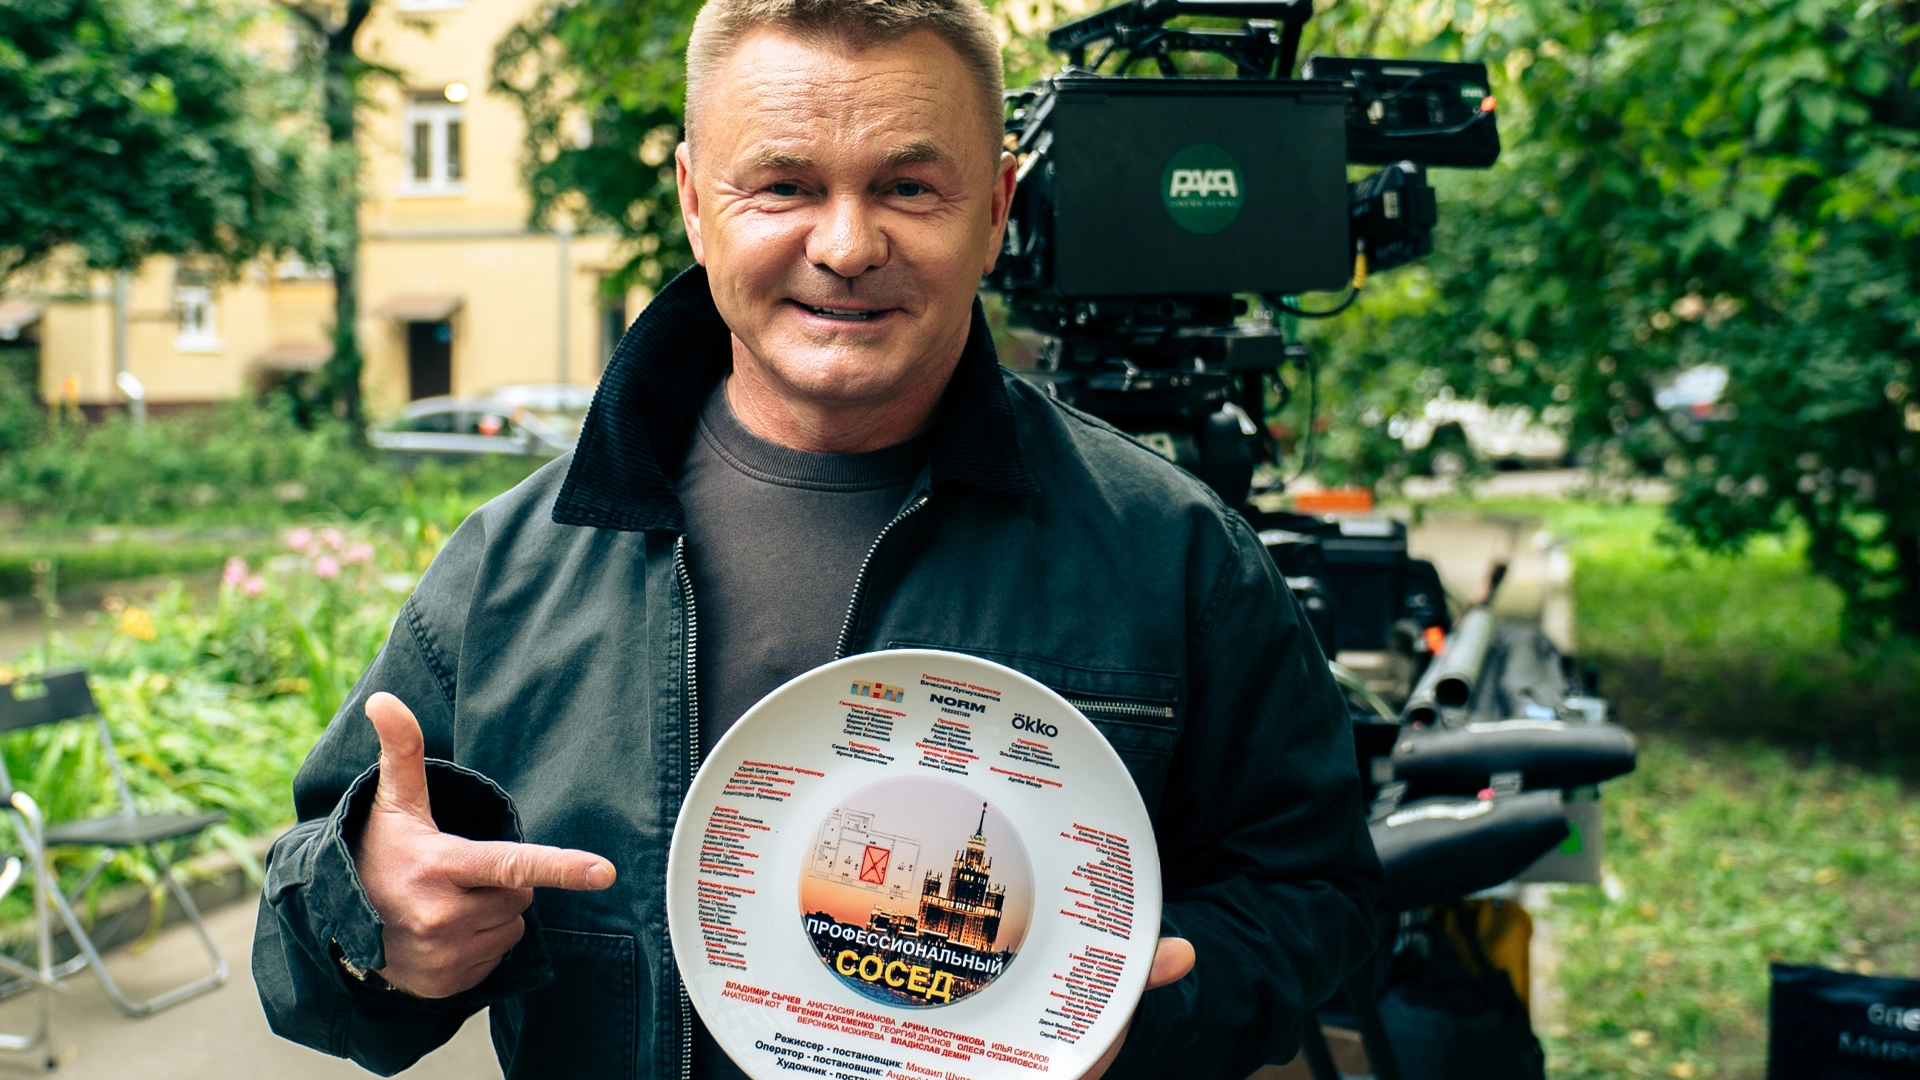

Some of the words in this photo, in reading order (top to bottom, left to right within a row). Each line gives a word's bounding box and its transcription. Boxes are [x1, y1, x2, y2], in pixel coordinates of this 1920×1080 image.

[920, 679, 952, 690] Вячеслав
[952, 686, 1000, 702] Дусмухаметов
[922, 673, 967, 688] Генеральный
[968, 684, 1001, 696] продюсер
[839, 700, 874, 711] Генеральные
[875, 708, 906, 717] продюсеры
[930, 693, 986, 713] NORM
[941, 707, 970, 717] PRODUCTION
[933, 723, 953, 731] Андрей
[937, 718, 969, 729] Продюсеры
[843, 728, 862, 736] Сергей
[848, 741, 880, 751] Продюсеры
[922, 738, 946, 746] Дмитрий
[1011, 742, 1030, 750] Сергей
[1017, 738, 1048, 749] Продюсеры
[836, 750, 853, 758] Ирина
[915, 742, 947, 753] Креативные
[948, 750, 979, 760] продюсеры
[923, 750, 943, 758] авторы
[944, 755, 969, 763] сценария
[742, 760, 794, 771] Исполнительный
[794, 768, 825, 778] продюсер
[918, 760, 940, 769] Евгений
[734, 771, 764, 779] Линейный
[765, 776, 795, 785] продюсер
[990, 766, 1036, 781] Исполнительный
[1036, 778, 1062, 788] продюсер
[722, 788, 755, 798] Александра
[725, 782, 755, 791] Ассистент
[758, 788, 791, 797] продюсера
[714, 806, 739, 814] Директор
[742, 823, 770, 831] директора
[698, 879, 722, 889] Бригадир
[806, 918, 1004, 975] ПРОФЕССИОНАЛЬНЫЙ
[836, 949, 954, 1004] СОСЕД
[725, 981, 770, 997] ВЛАДИМИР
[771, 992, 801, 1004] СЫЧЕВ
[806, 1000, 855, 1016] АНАСТАСИЯ
[856, 1011, 896, 1026] ИМАМОВА
[901, 1021, 929, 1033] АРИНА
[931, 1028, 985, 1047] ПОСТНИКОВА
[991, 1043, 1013, 1053] ИЛЬЯ
[1014, 1048, 1049, 1062] СИГАЛОВ
[721, 989, 764, 1005] АНАТОЛИЙ
[764, 999, 781, 1008] КОТ
[786, 1004, 824, 1018] ЕВГЕНИЯ
[825, 1013, 874, 1029] АХРЕМЕНКО
[880, 1022, 917, 1039] ГЕОРГИЙ
[917, 1034, 951, 1048] ДРОНОВ
[957, 1043, 985, 1056] ОЛЕСЯ
[986, 1050, 1048, 1072] СУДЗИЛОВСКАЯ
[797, 1016, 839, 1031] ВЕРОНИКА
[841, 1025, 884, 1041] МОХИРЕВА
[890, 1036, 941, 1054] ВЛАДИСЛАВ
[941, 1049, 971, 1061] ДЕМИН
[755, 1040, 804, 1060] Оператор
[813, 1055, 883, 1076] постановщик:
[774, 1032, 824, 1052] Режиссер
[832, 1047, 903, 1068] постановщик:
[906, 1062, 943, 1078] Михаил
[776, 1057, 827, 1076] Художник
